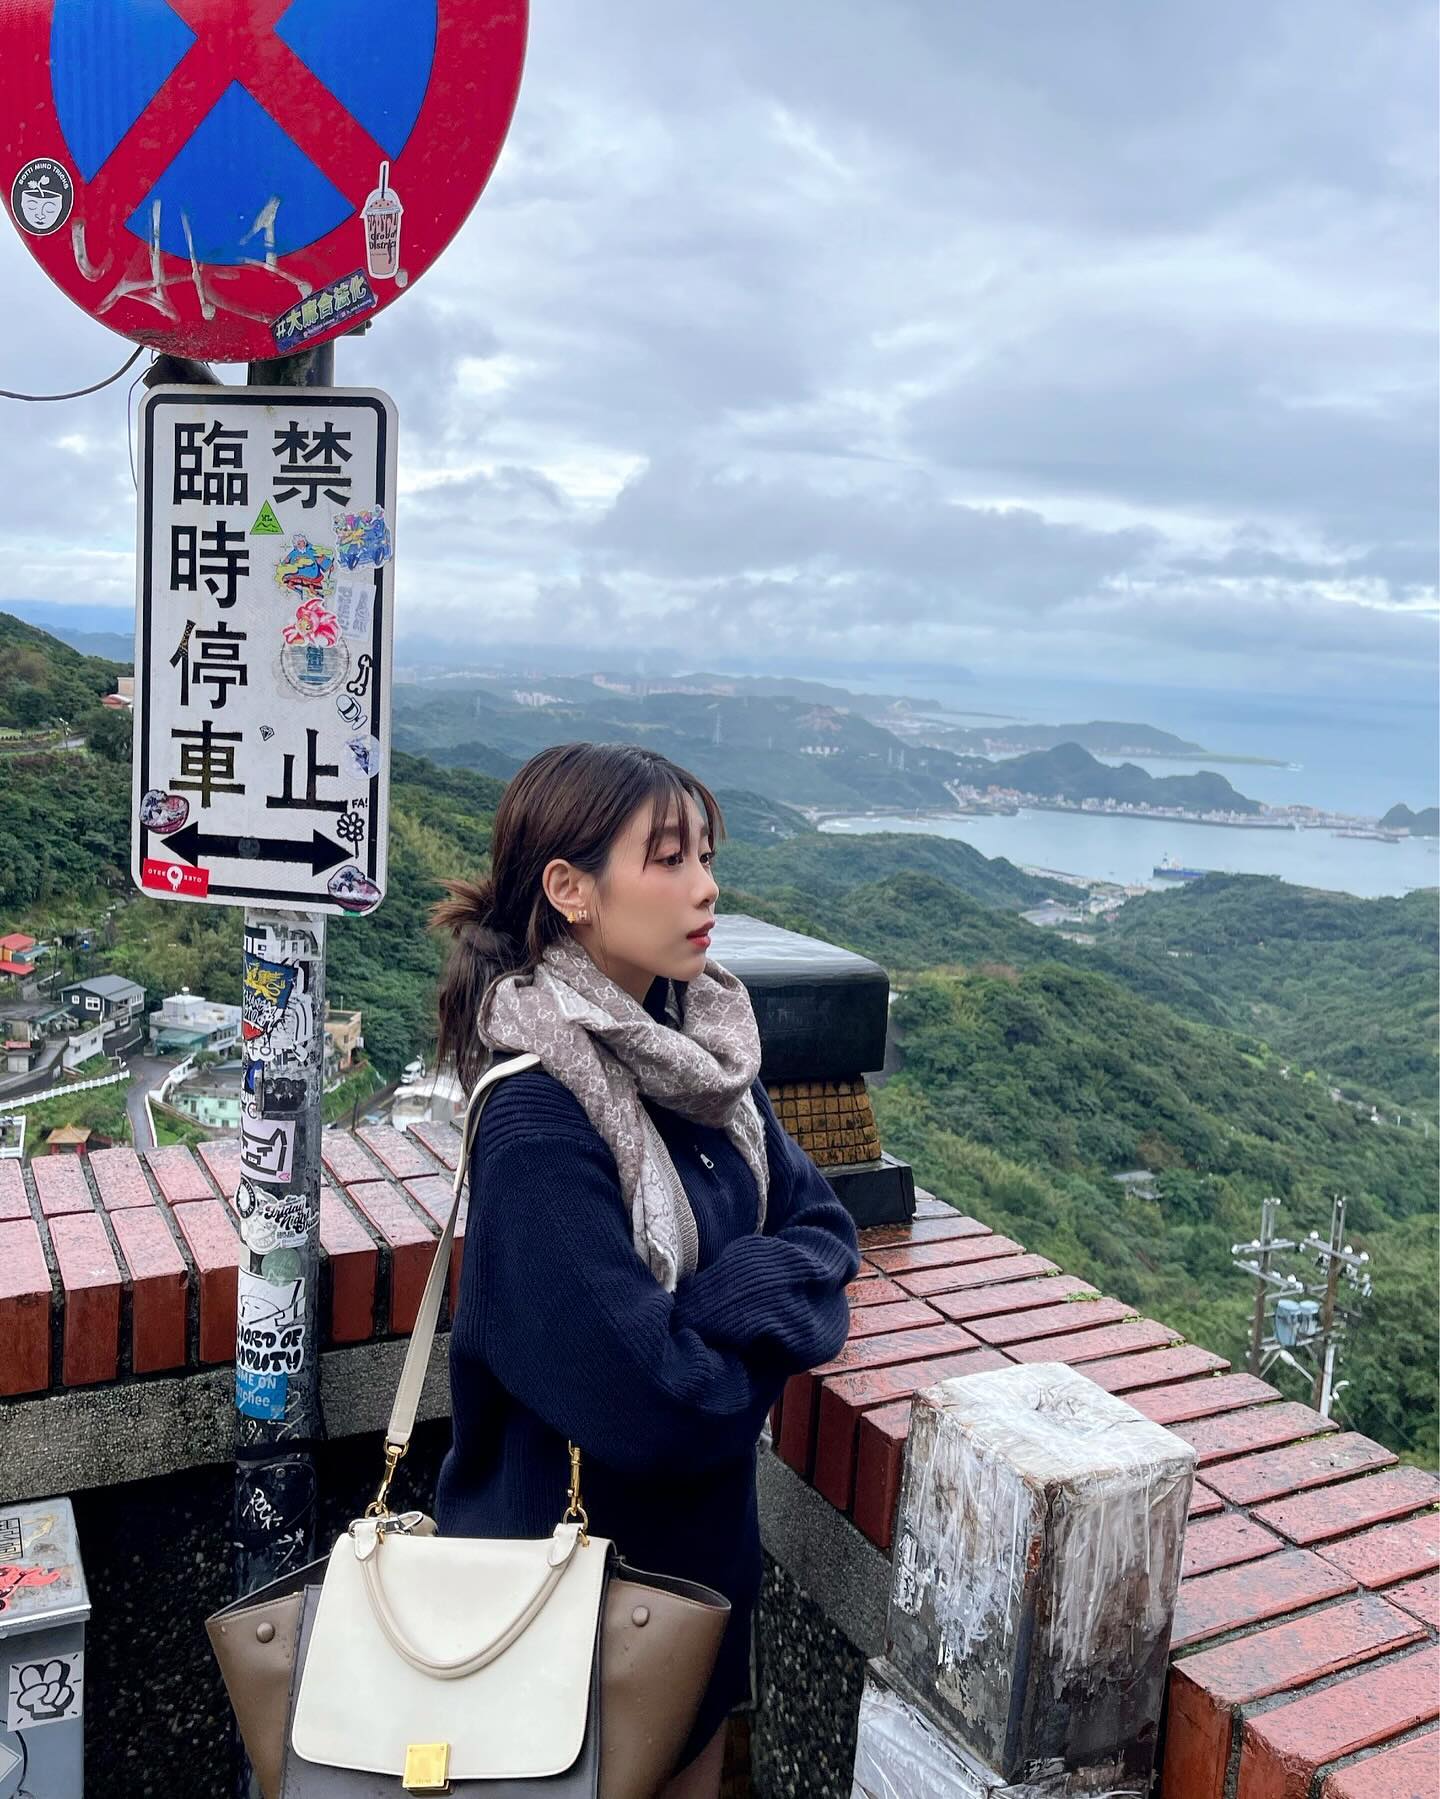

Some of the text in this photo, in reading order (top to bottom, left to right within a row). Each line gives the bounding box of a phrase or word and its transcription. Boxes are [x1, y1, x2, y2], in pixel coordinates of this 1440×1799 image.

[169, 420, 249, 809] 臨時停車
[352, 797, 368, 808] FA!
[280, 1327, 303, 1349] OF
[258, 1375, 277, 1389] ON
